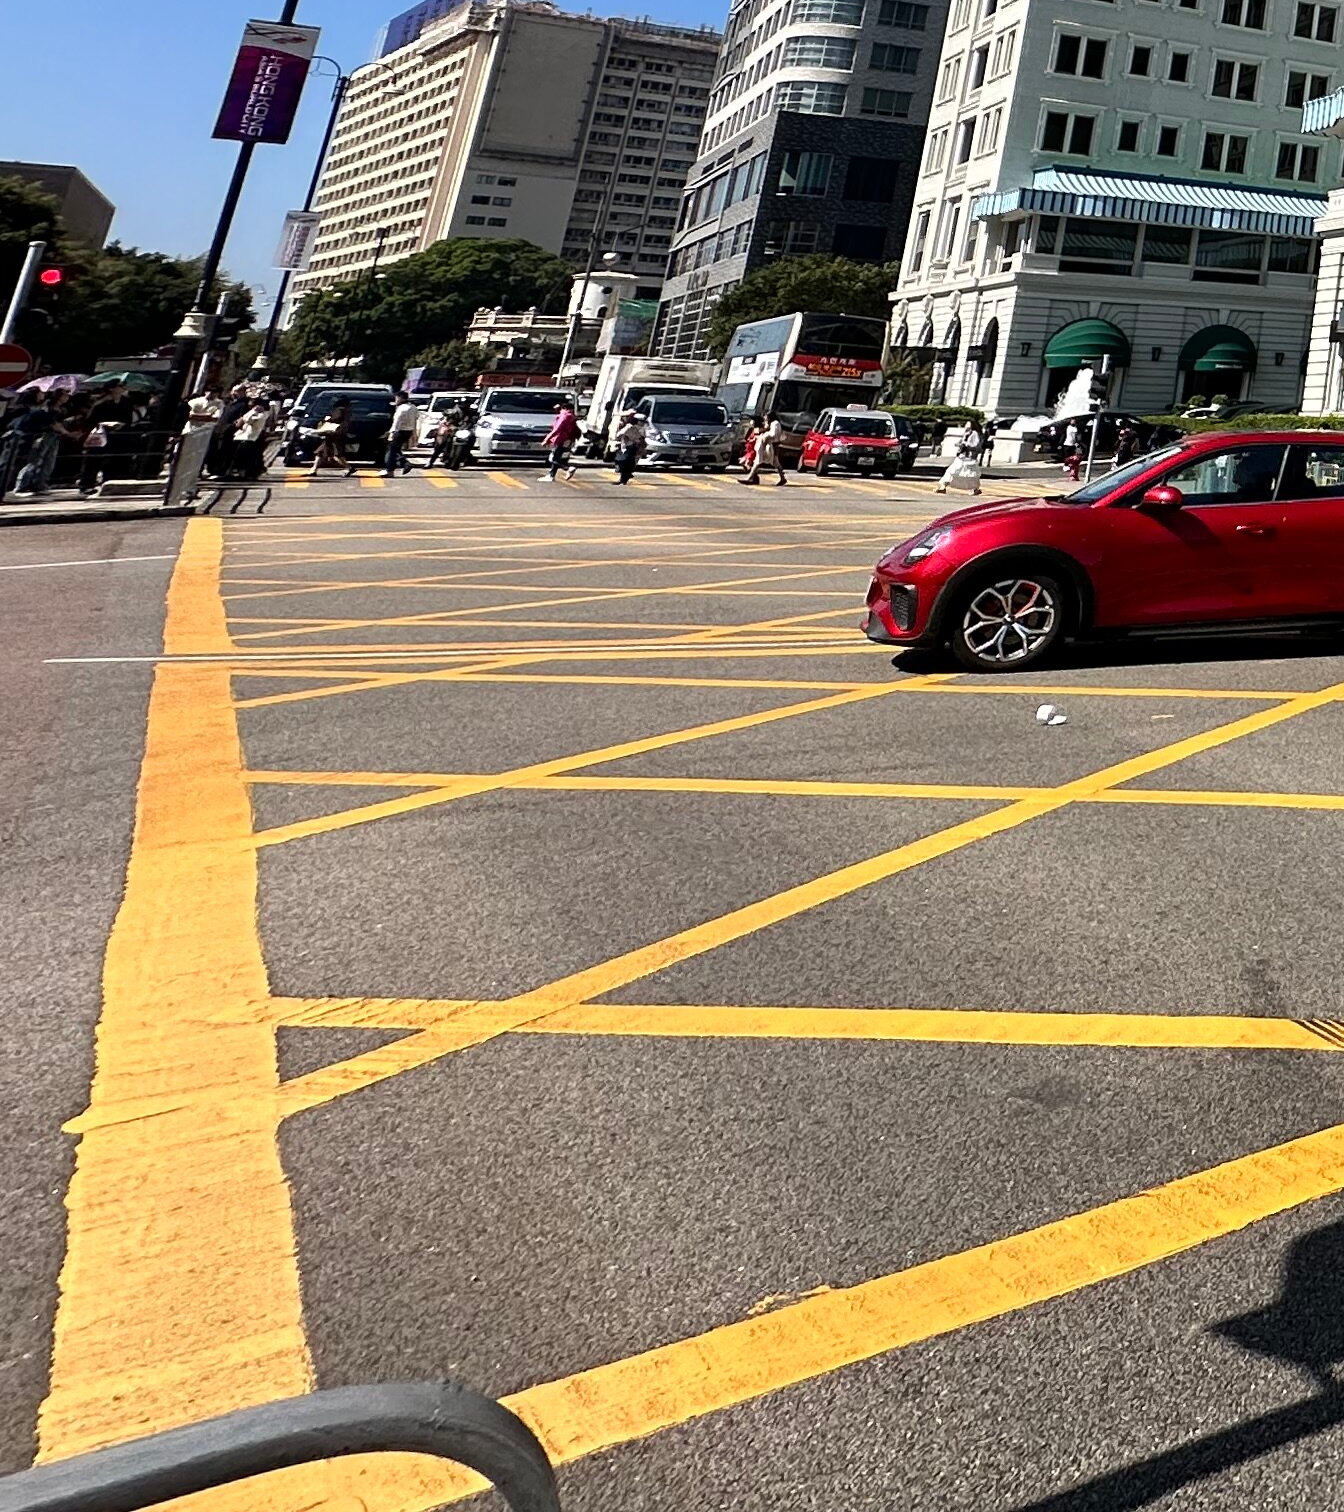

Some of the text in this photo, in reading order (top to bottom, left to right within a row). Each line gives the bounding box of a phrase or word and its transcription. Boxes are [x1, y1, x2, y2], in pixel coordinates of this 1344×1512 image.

[247, 55, 284, 136] HONG KONG
[238, 114, 250, 134] CITY
